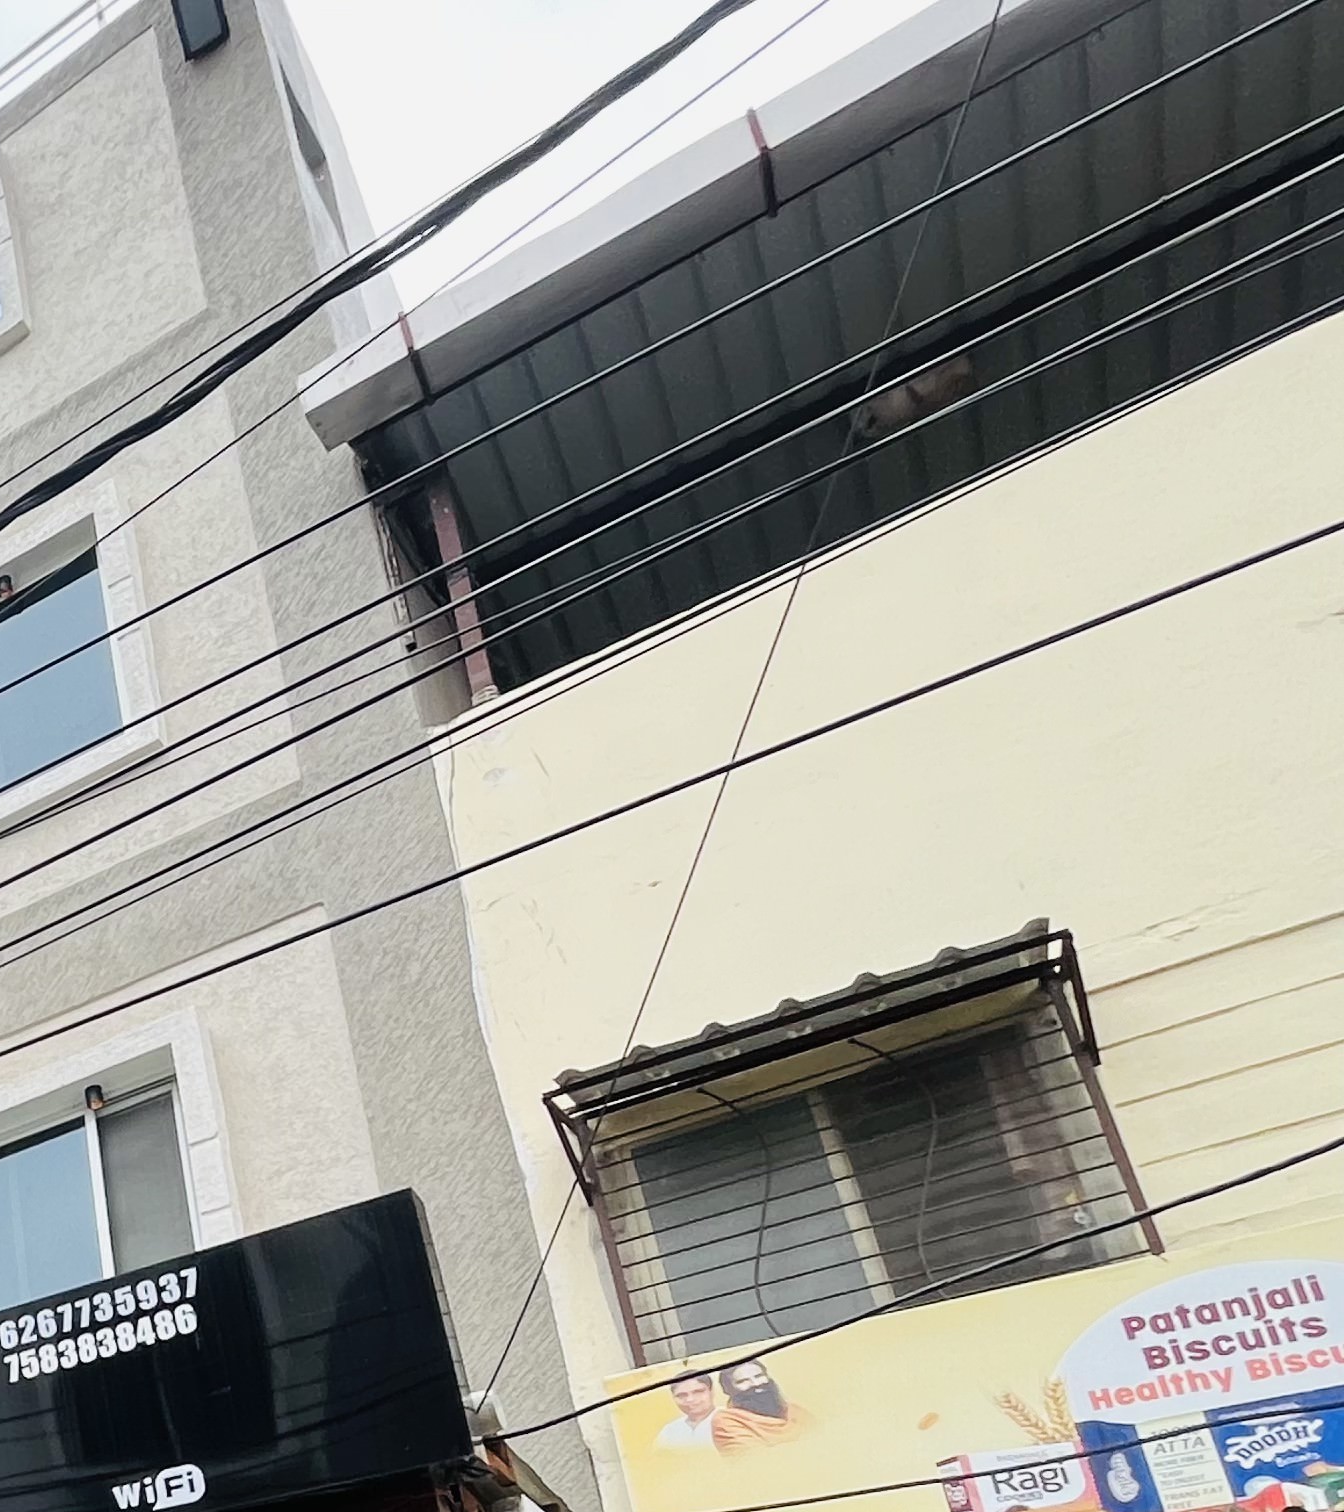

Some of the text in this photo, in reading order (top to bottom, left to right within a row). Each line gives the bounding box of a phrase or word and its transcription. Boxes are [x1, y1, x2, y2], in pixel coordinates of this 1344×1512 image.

[1121, 1274, 1325, 1340] Patanjali
[3, 1302, 199, 1385] 7583838486
[1142, 1316, 1328, 1370] Biscuits
[1088, 1366, 1233, 1411] Healthy
[1153, 1436, 1206, 1455] ATTA
[1234, 1425, 1310, 1460] DOODH
[991, 1462, 1070, 1495] Ragi
